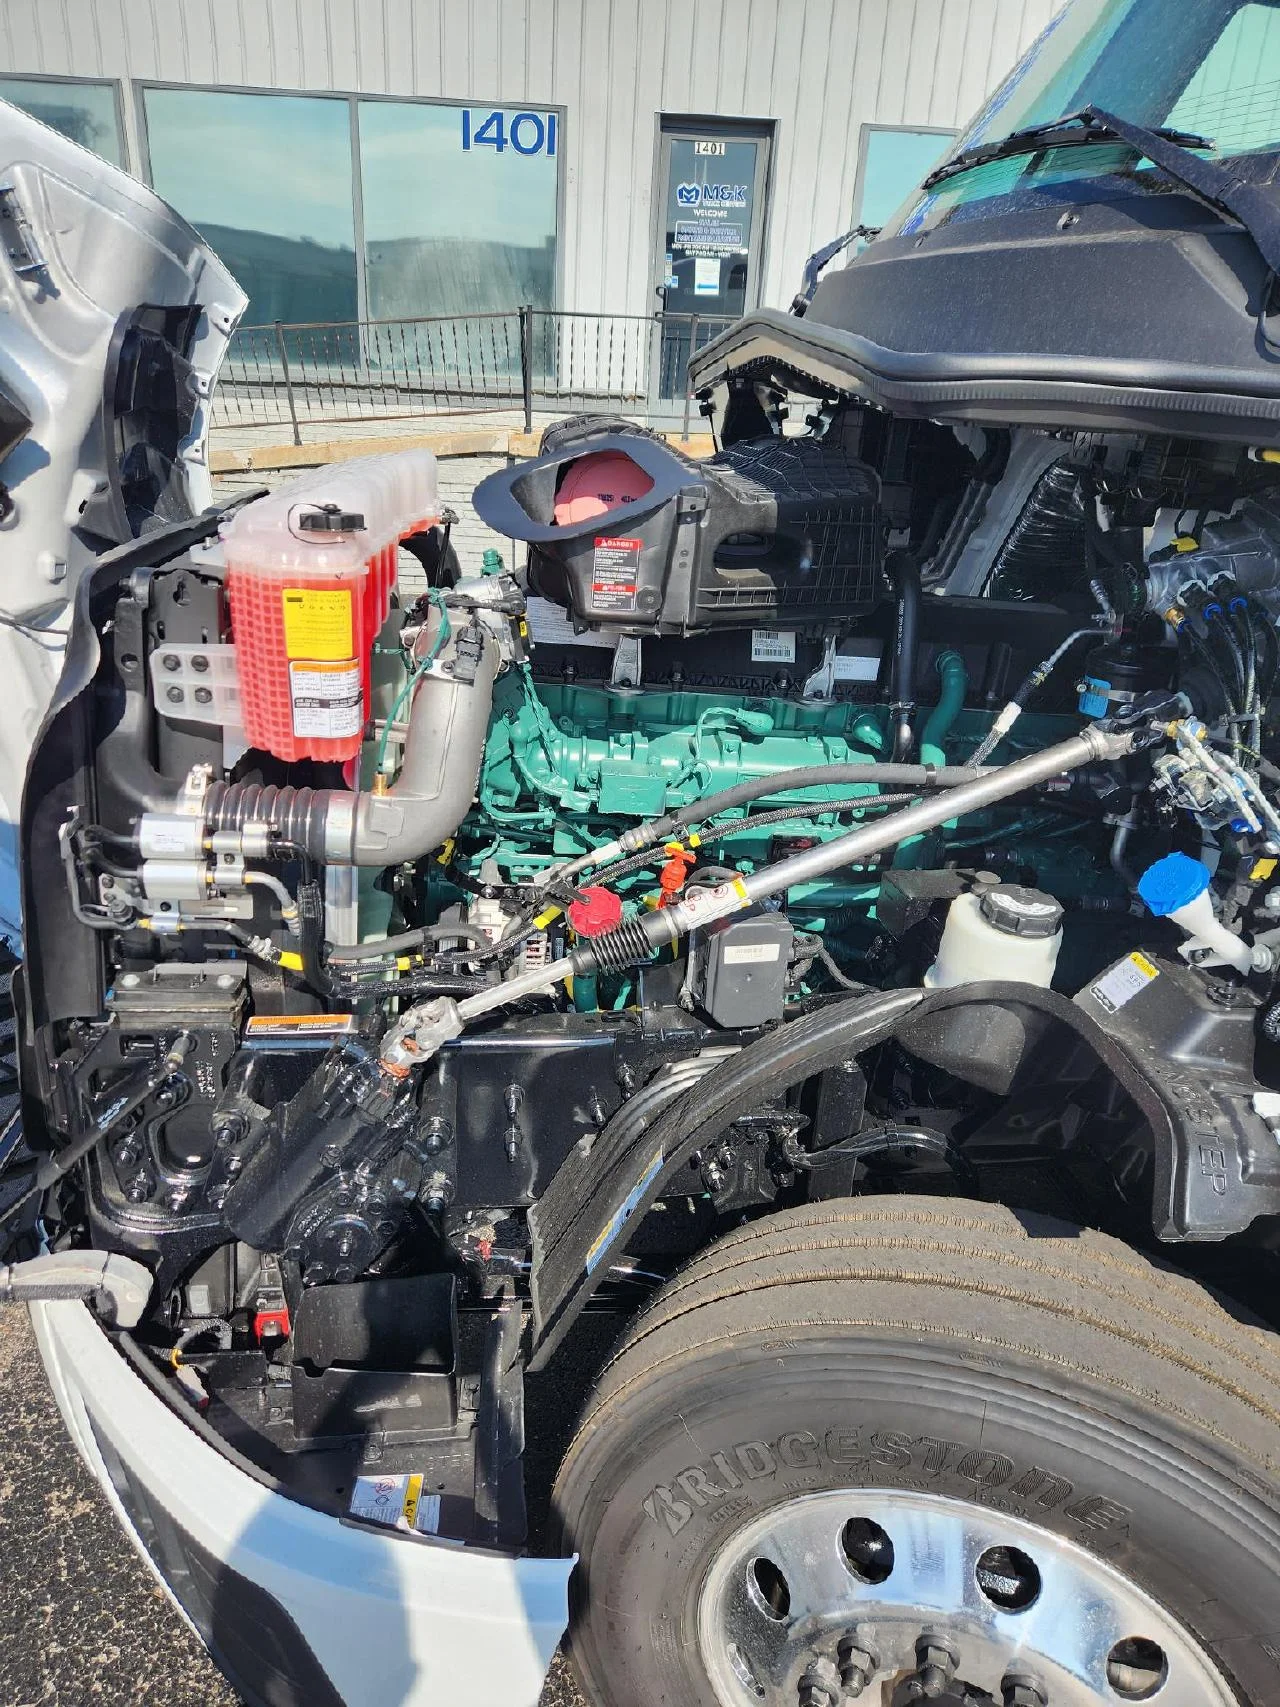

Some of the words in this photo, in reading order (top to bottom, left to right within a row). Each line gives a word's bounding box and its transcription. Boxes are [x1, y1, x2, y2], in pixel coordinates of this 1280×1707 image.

[462, 109, 556, 155] 1401
[696, 142, 724, 155] 1401
[702, 184, 747, 201] M&K
[693, 209, 728, 217] WELCOME
[642, 1424, 1135, 1537] BRIDGESTONE
